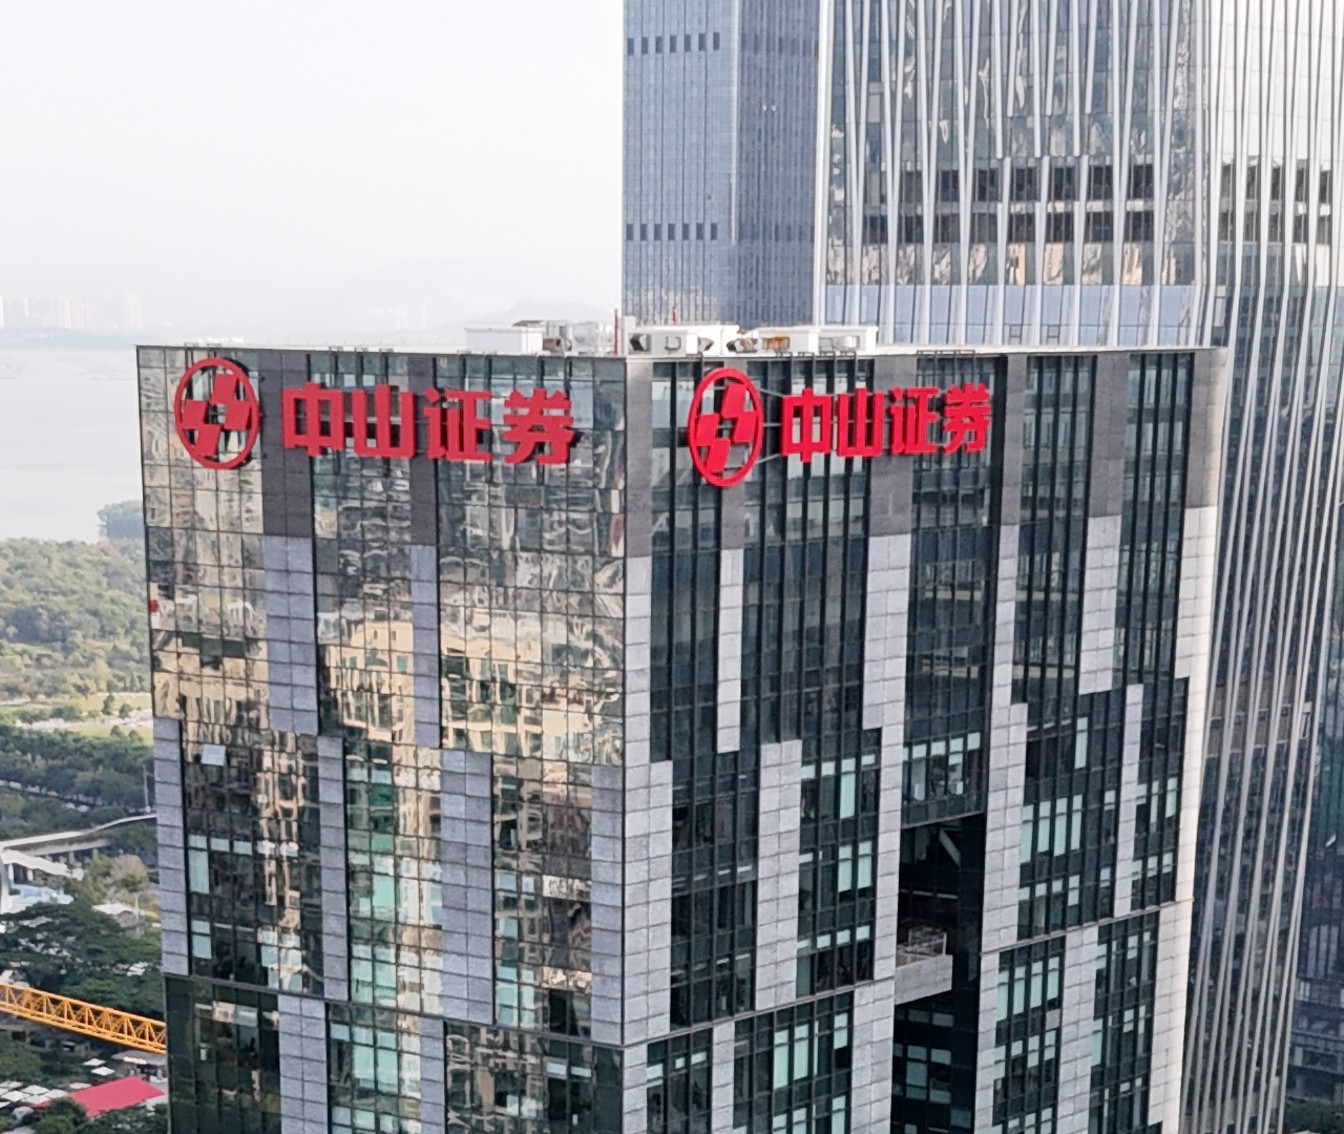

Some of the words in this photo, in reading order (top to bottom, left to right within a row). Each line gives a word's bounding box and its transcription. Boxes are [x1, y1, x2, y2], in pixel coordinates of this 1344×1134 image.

[281, 382, 577, 466] 中山证券
[780, 382, 992, 464] 中山证券
